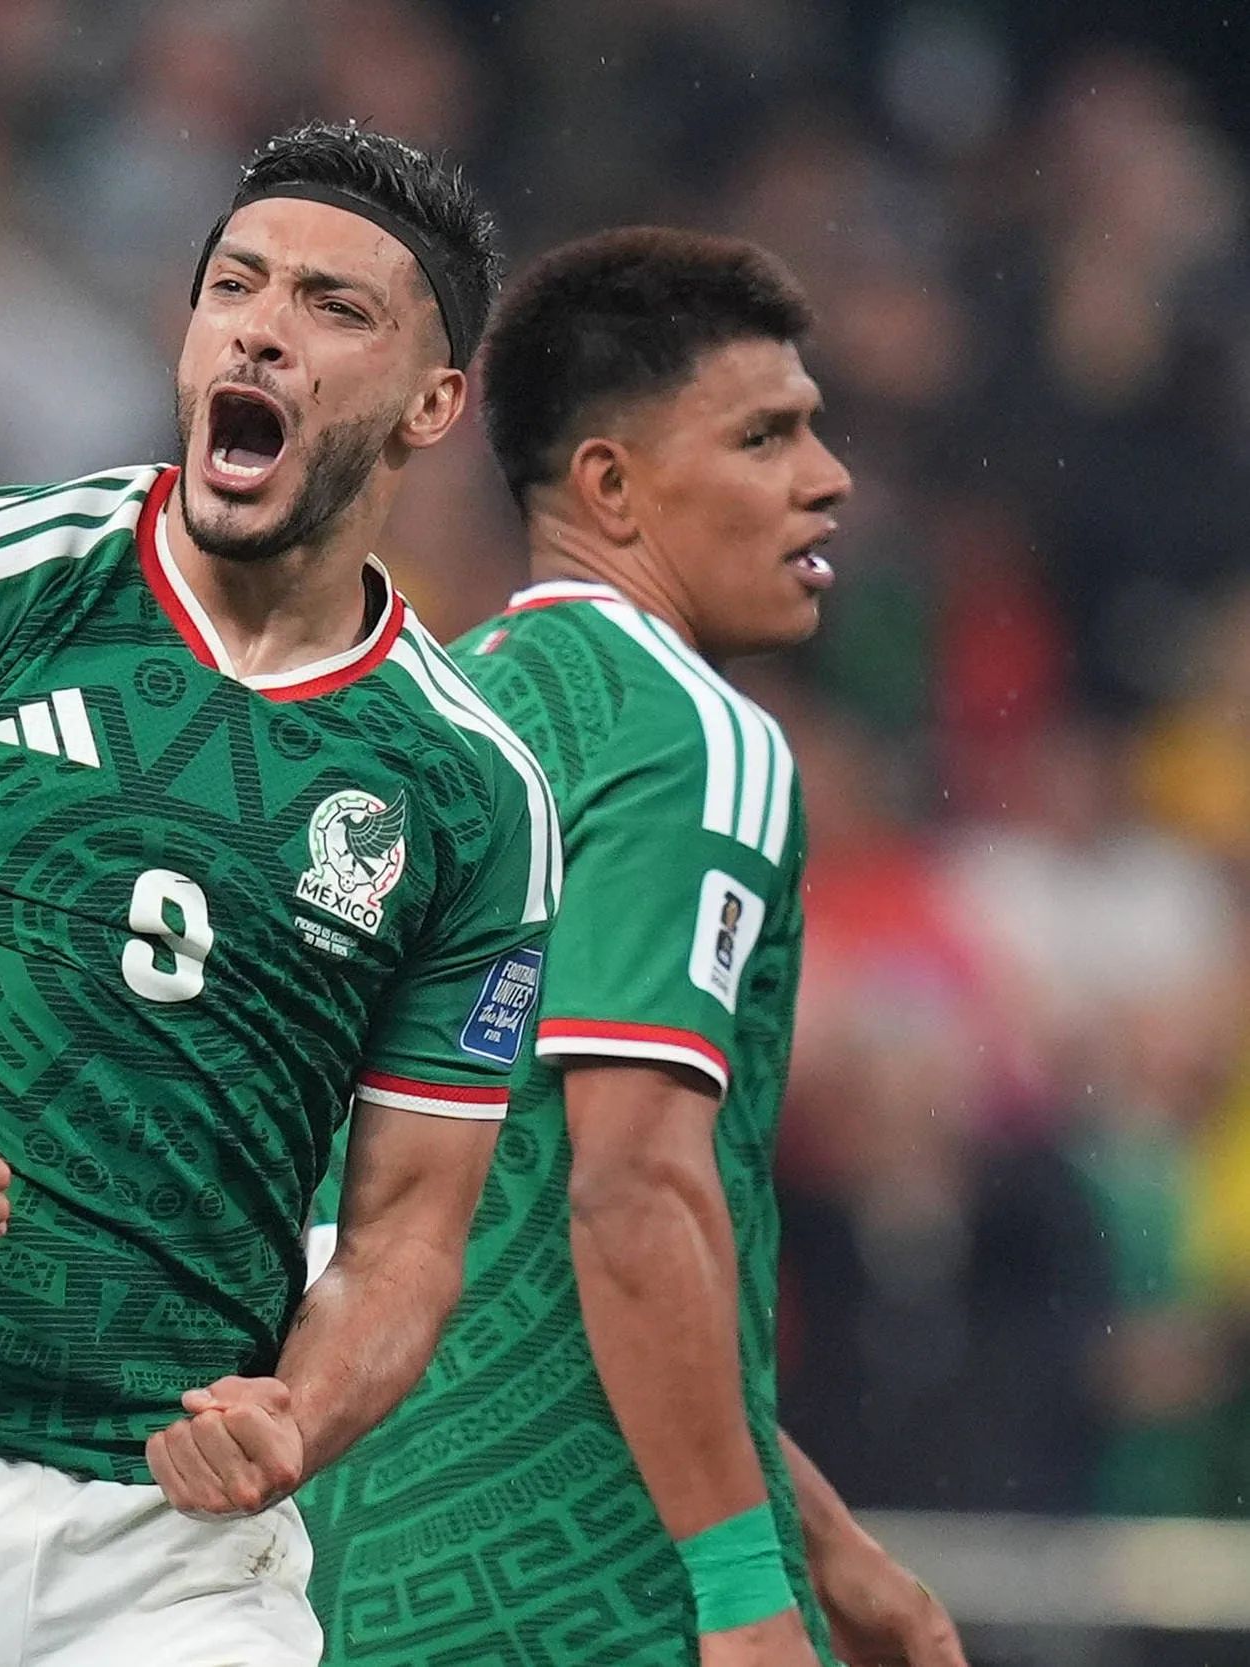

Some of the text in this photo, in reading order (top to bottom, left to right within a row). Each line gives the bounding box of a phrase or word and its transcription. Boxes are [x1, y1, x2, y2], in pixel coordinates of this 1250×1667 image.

[300, 877, 378, 928] MÉXICO
[121, 868, 214, 1003] 9
[491, 978, 535, 1010] UNITES
